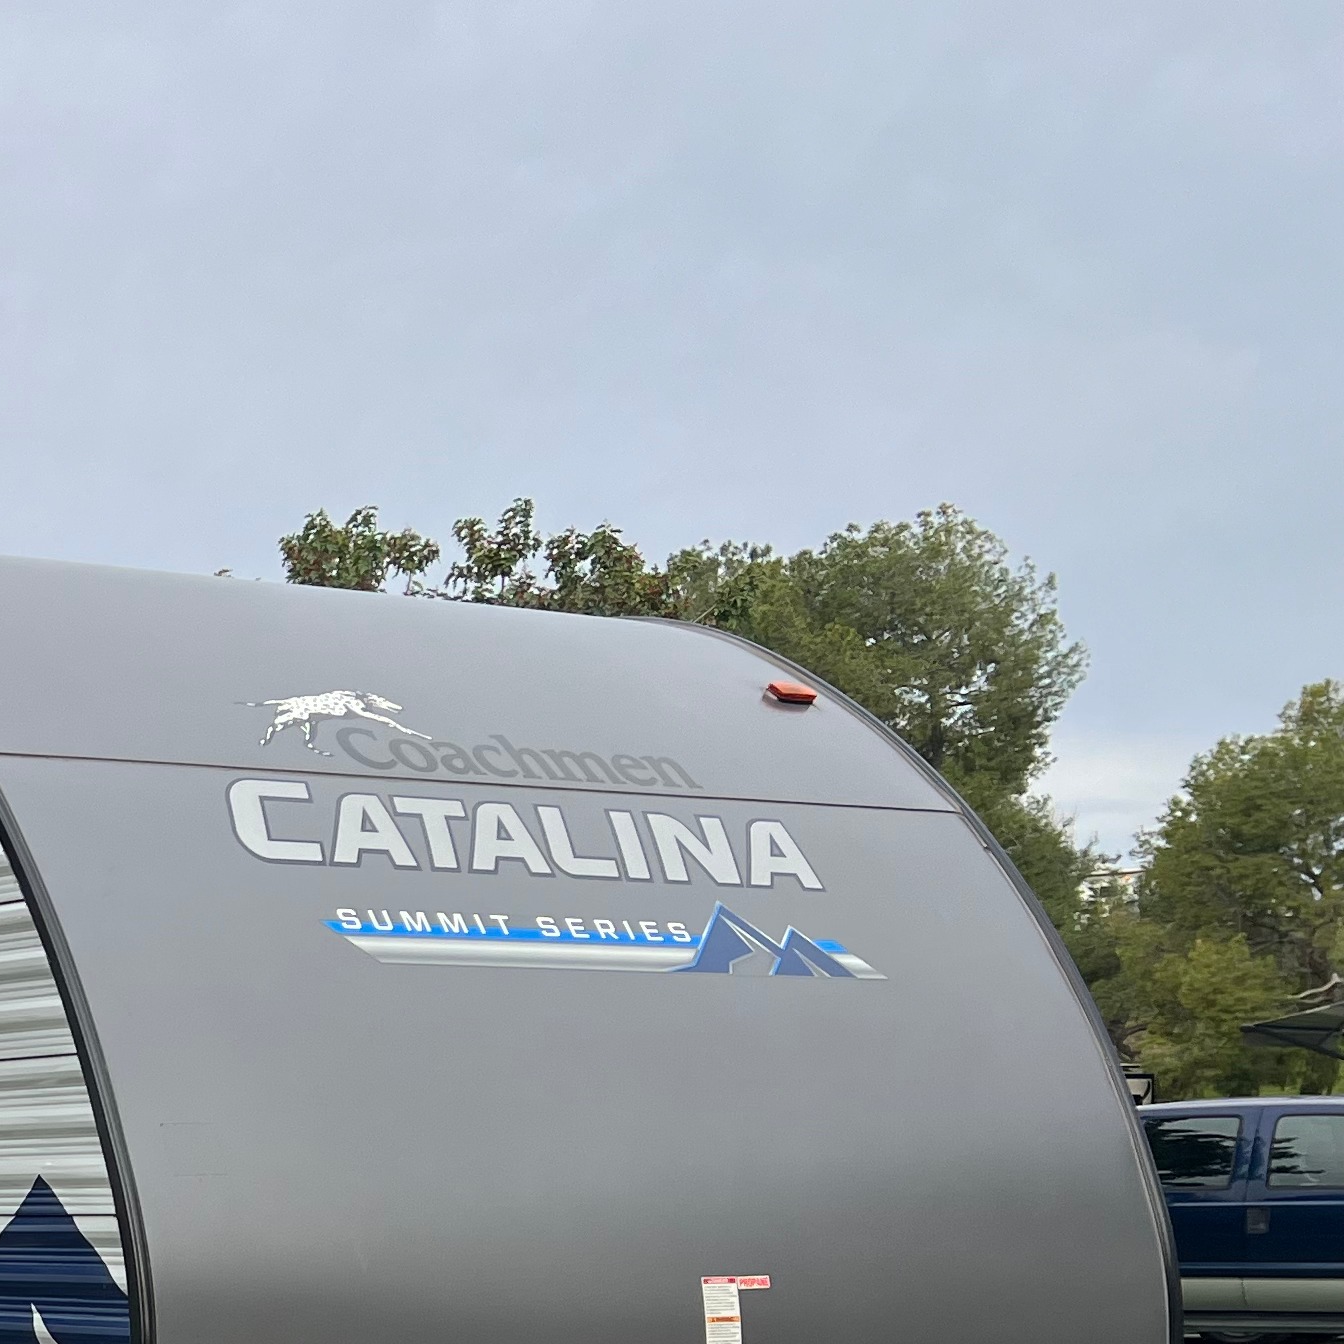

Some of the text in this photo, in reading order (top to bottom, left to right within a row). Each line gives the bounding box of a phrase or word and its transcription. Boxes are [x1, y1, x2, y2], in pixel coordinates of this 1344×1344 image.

[335, 726, 703, 790] Coachmen
[226, 777, 825, 892] CATALINA
[335, 906, 694, 944] SUMMIT SERIES
